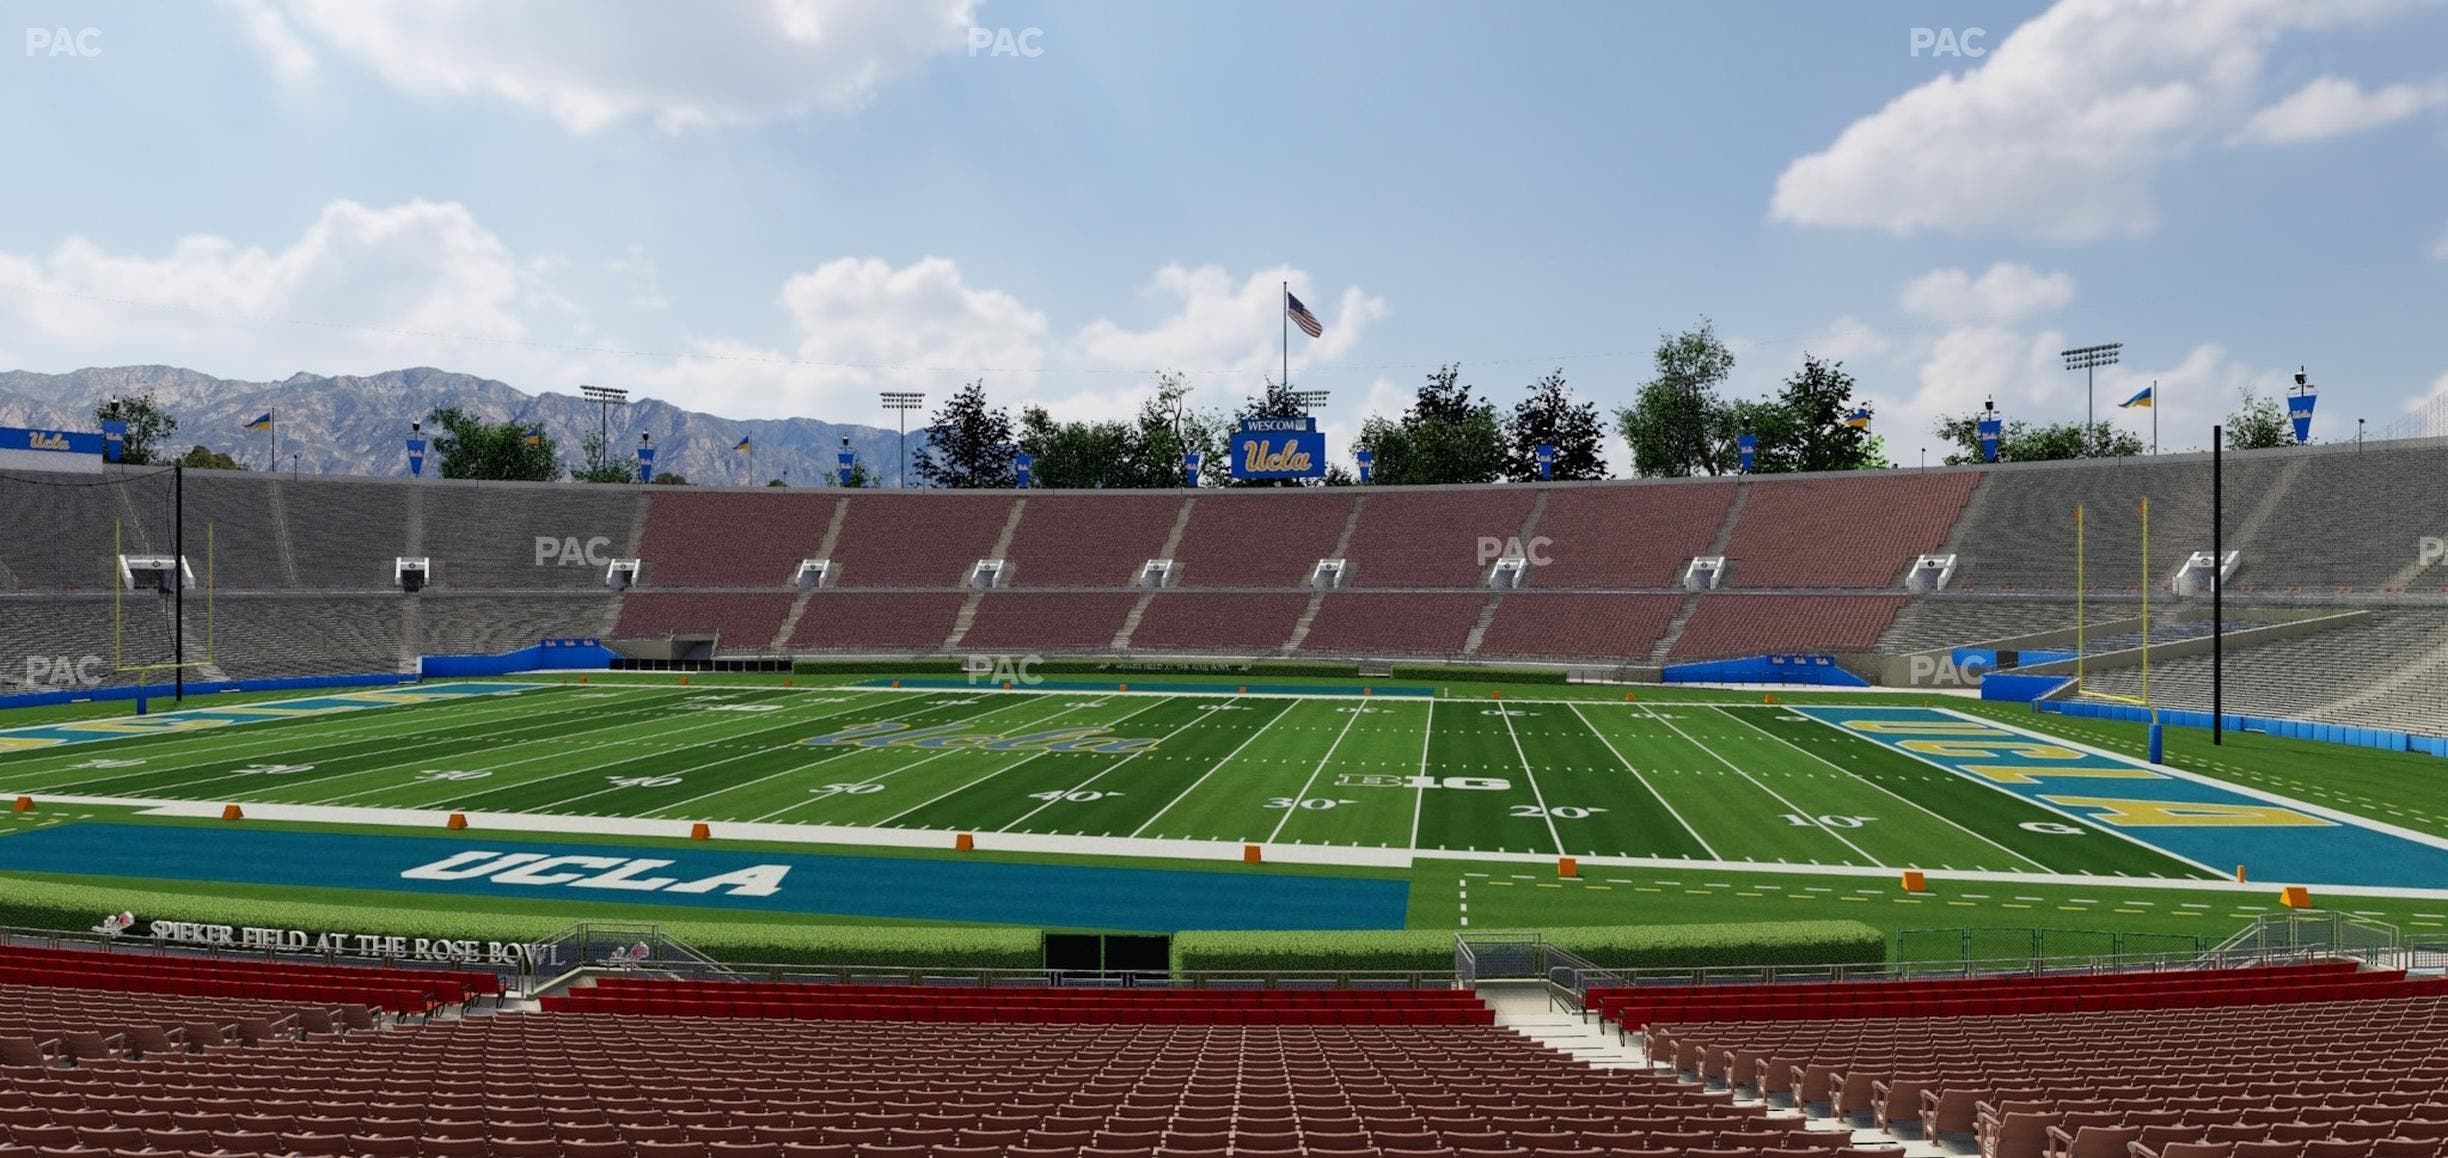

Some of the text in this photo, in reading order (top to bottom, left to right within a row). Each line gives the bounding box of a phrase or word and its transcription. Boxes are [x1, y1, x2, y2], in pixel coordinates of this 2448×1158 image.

[1248, 420, 1296, 431] WESCOM
[1243, 439, 1312, 472] Ucla
[1839, 719, 2343, 827] UCLA
[808, 783, 886, 794] 50
[1334, 773, 1512, 791] BIG
[1027, 790, 1103, 801] 40
[1262, 797, 1338, 810] 30
[1509, 805, 1591, 819] 20
[1777, 813, 1863, 828] 10
[2017, 822, 2087, 836] G
[400, 850, 793, 897] UCLA
[150, 920, 567, 967] SPIEKER FIELD AT THE ROSE BOWL
